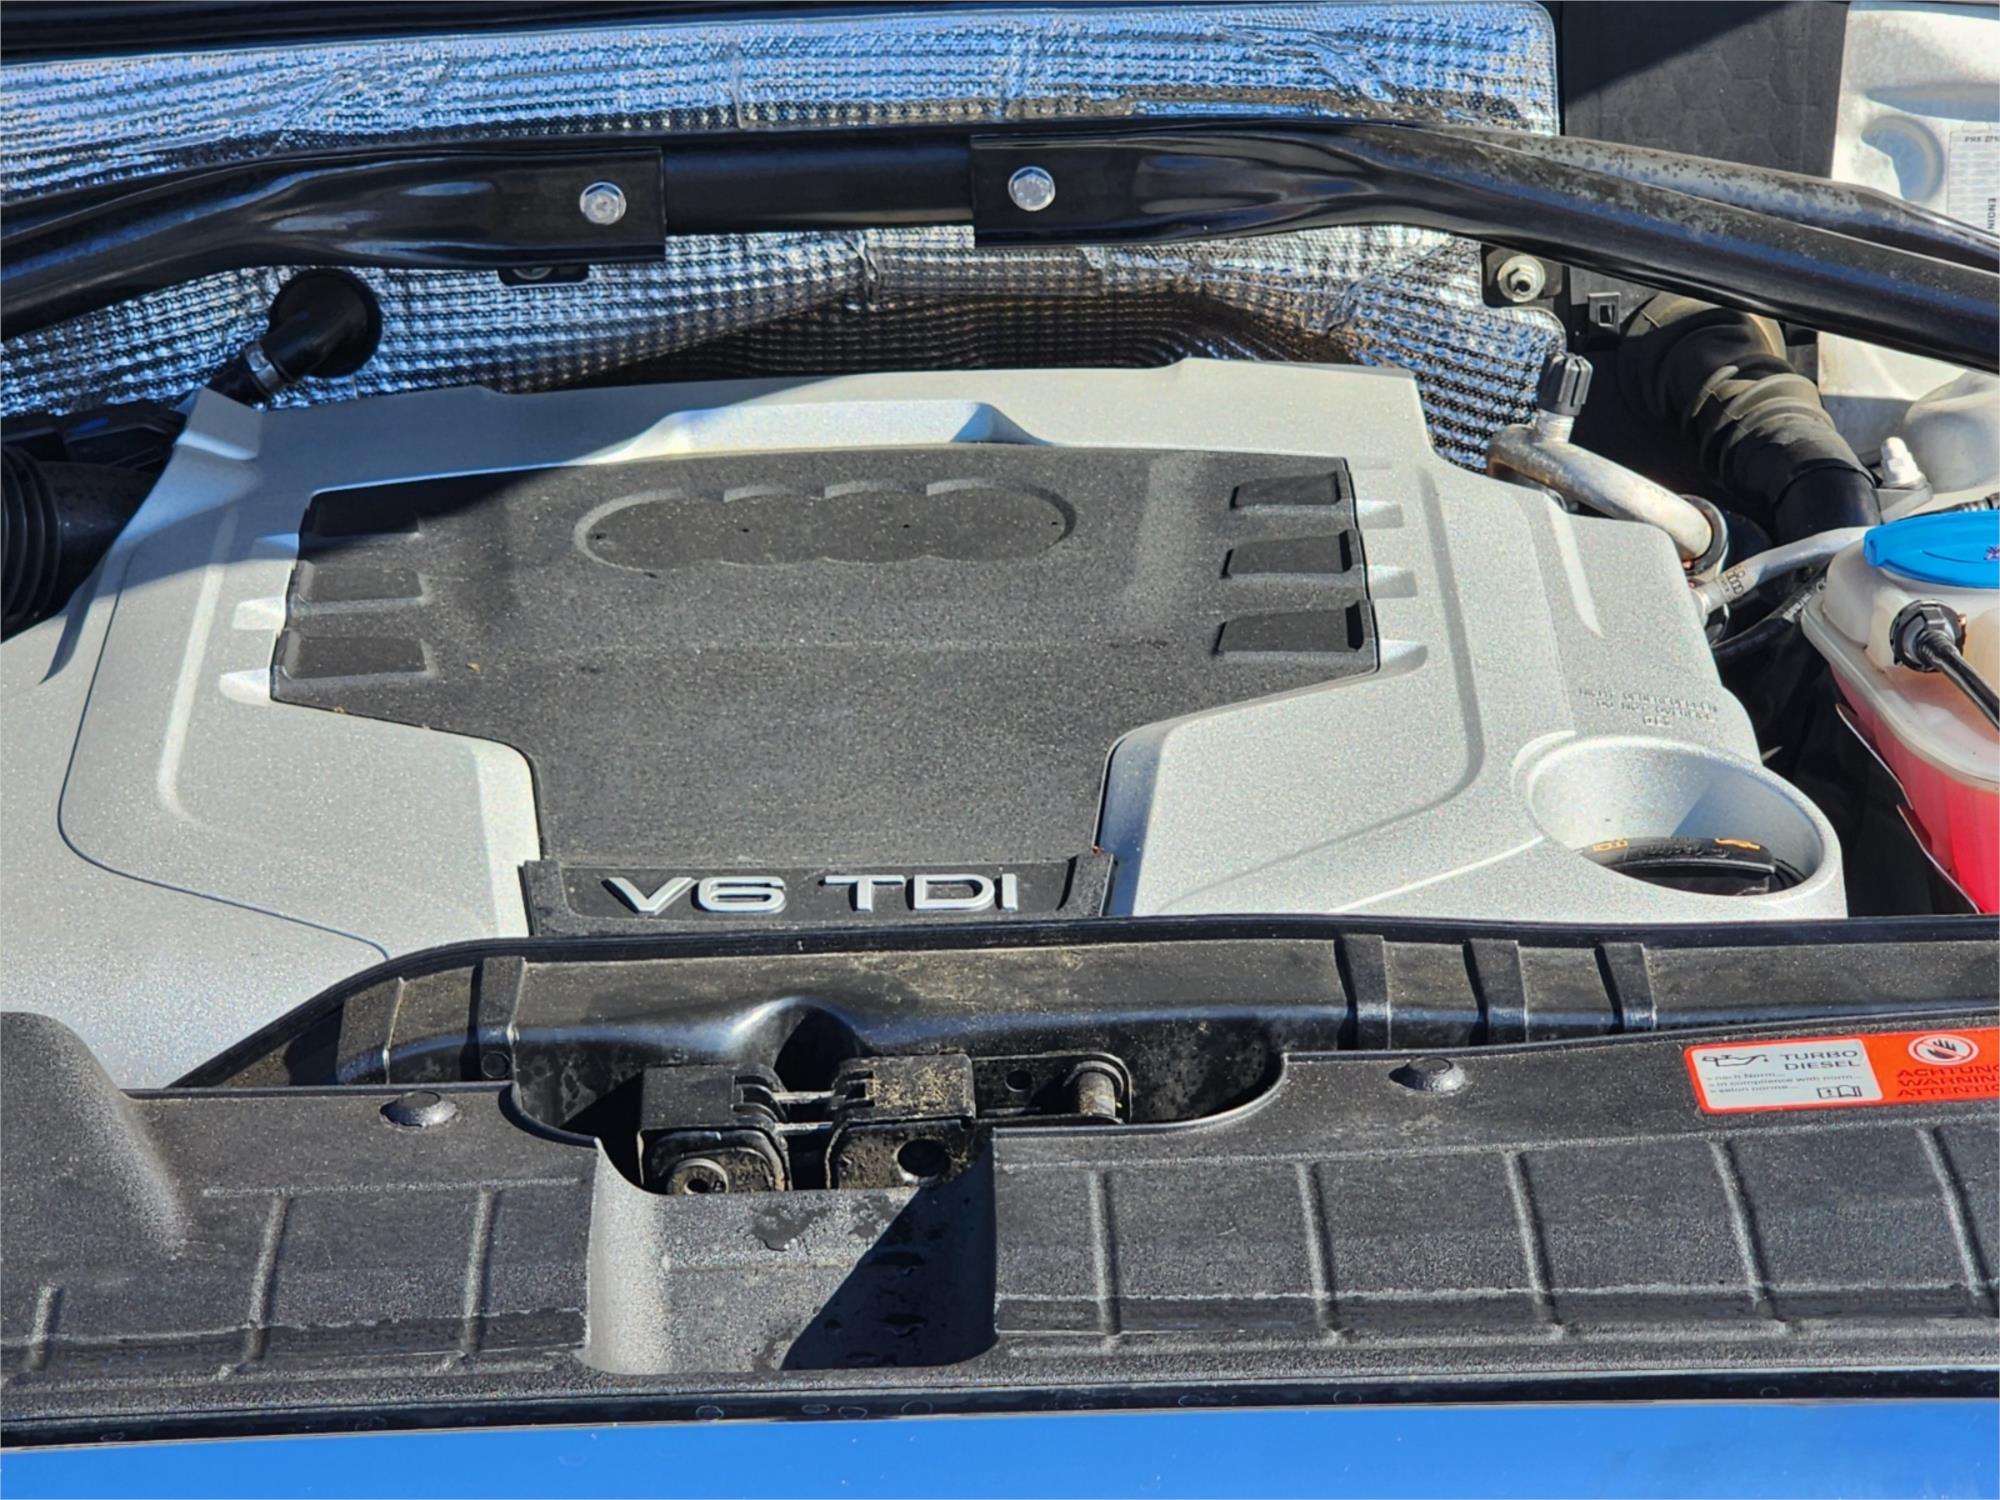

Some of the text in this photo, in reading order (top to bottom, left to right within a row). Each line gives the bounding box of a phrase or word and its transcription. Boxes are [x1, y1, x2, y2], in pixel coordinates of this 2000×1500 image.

[1986, 197, 1997, 232] ENGIN
[605, 873, 1019, 914] V6 TDI
[1779, 1050, 1858, 1061] TURBO
[1784, 1060, 1861, 1071] DIESEL
[1897, 1075, 1999, 1087] WARNIN
